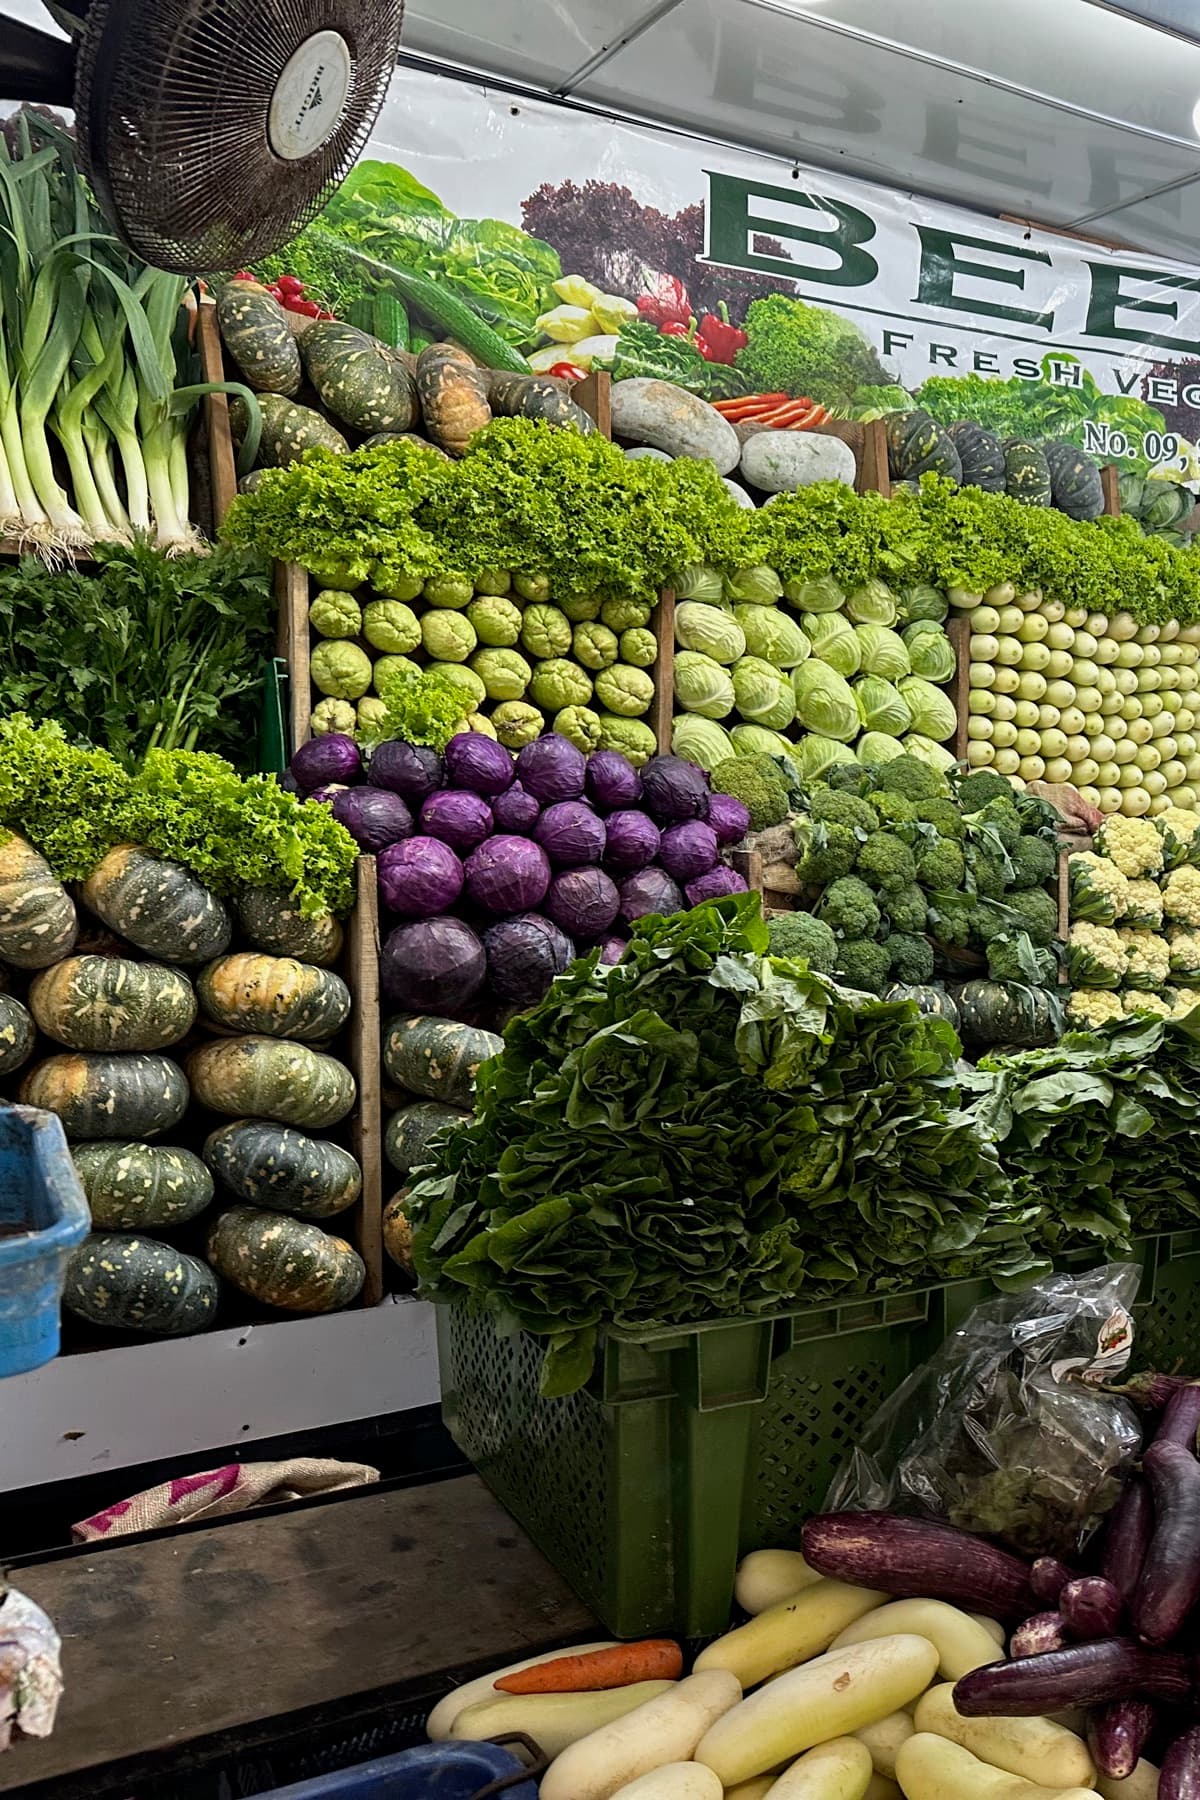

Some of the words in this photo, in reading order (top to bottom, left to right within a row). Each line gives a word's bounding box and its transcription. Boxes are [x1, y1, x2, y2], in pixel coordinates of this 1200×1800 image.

[882, 329, 1082, 387] FRESH
[1085, 422, 1136, 458] No.
[1145, 432, 1188, 471] 09,
